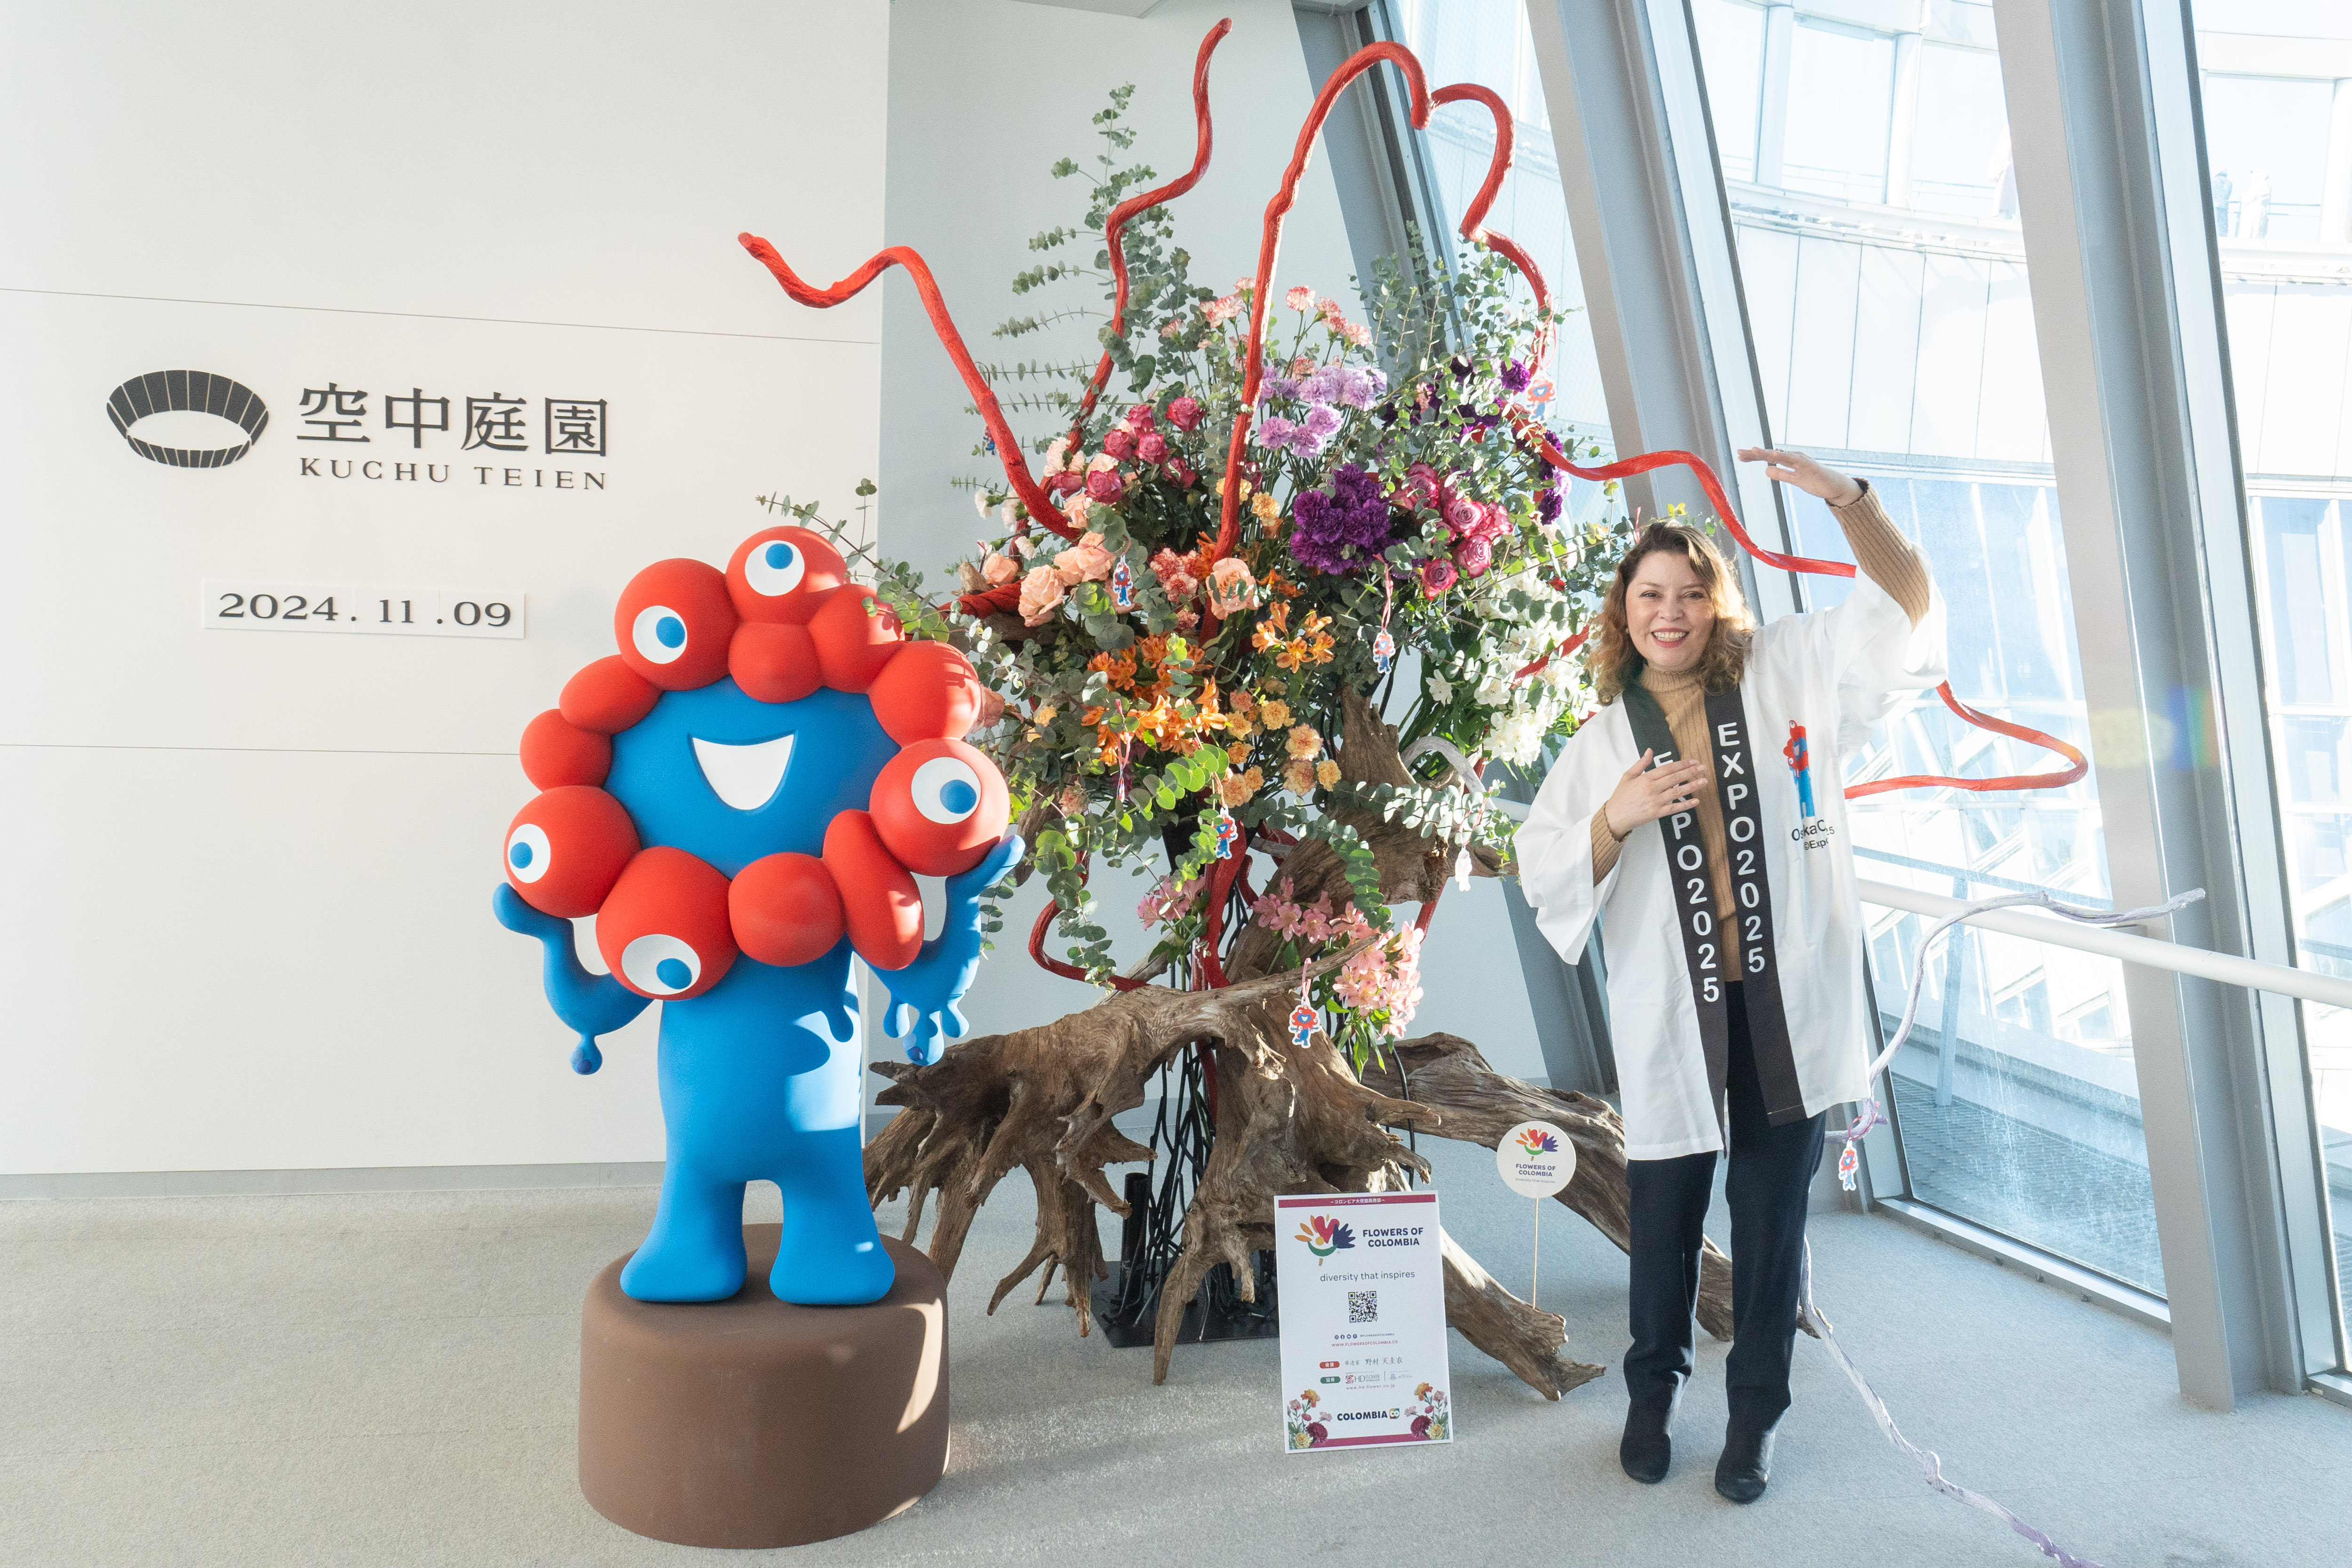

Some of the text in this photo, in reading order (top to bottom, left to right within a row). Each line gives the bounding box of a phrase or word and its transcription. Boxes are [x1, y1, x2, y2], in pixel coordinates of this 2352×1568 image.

[296, 382, 607, 457] 空中庭園
[300, 457, 606, 490] KUCHU TEIEN
[1717, 722, 1765, 973] EXPO2025
[1653, 751, 1719, 1002] EPO2025
[1363, 1228, 1408, 1237] FLOWERS
[1368, 1238, 1420, 1248] COLOMBIA
[1320, 1271, 1415, 1282] diversity that inspires
[1337, 1410, 1388, 1421] COLOMBIA
